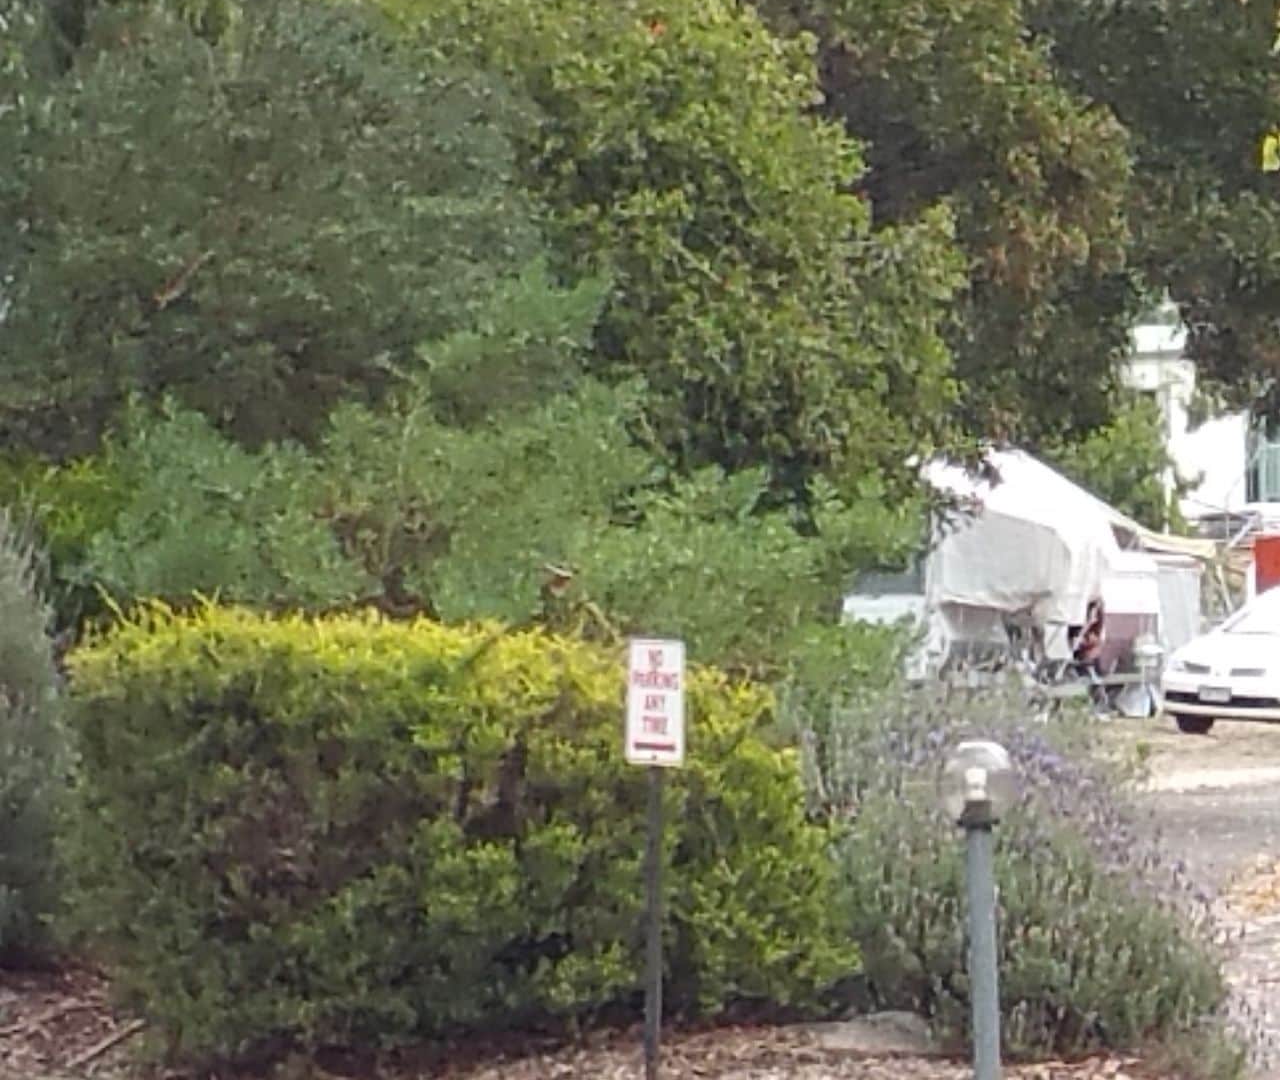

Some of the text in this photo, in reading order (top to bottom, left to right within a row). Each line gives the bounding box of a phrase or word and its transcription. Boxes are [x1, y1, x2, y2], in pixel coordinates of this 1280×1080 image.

[648, 649, 663, 666] NO
[632, 671, 679, 690] PARKING
[644, 695, 666, 711] ANY
[642, 715, 668, 735] TIME
